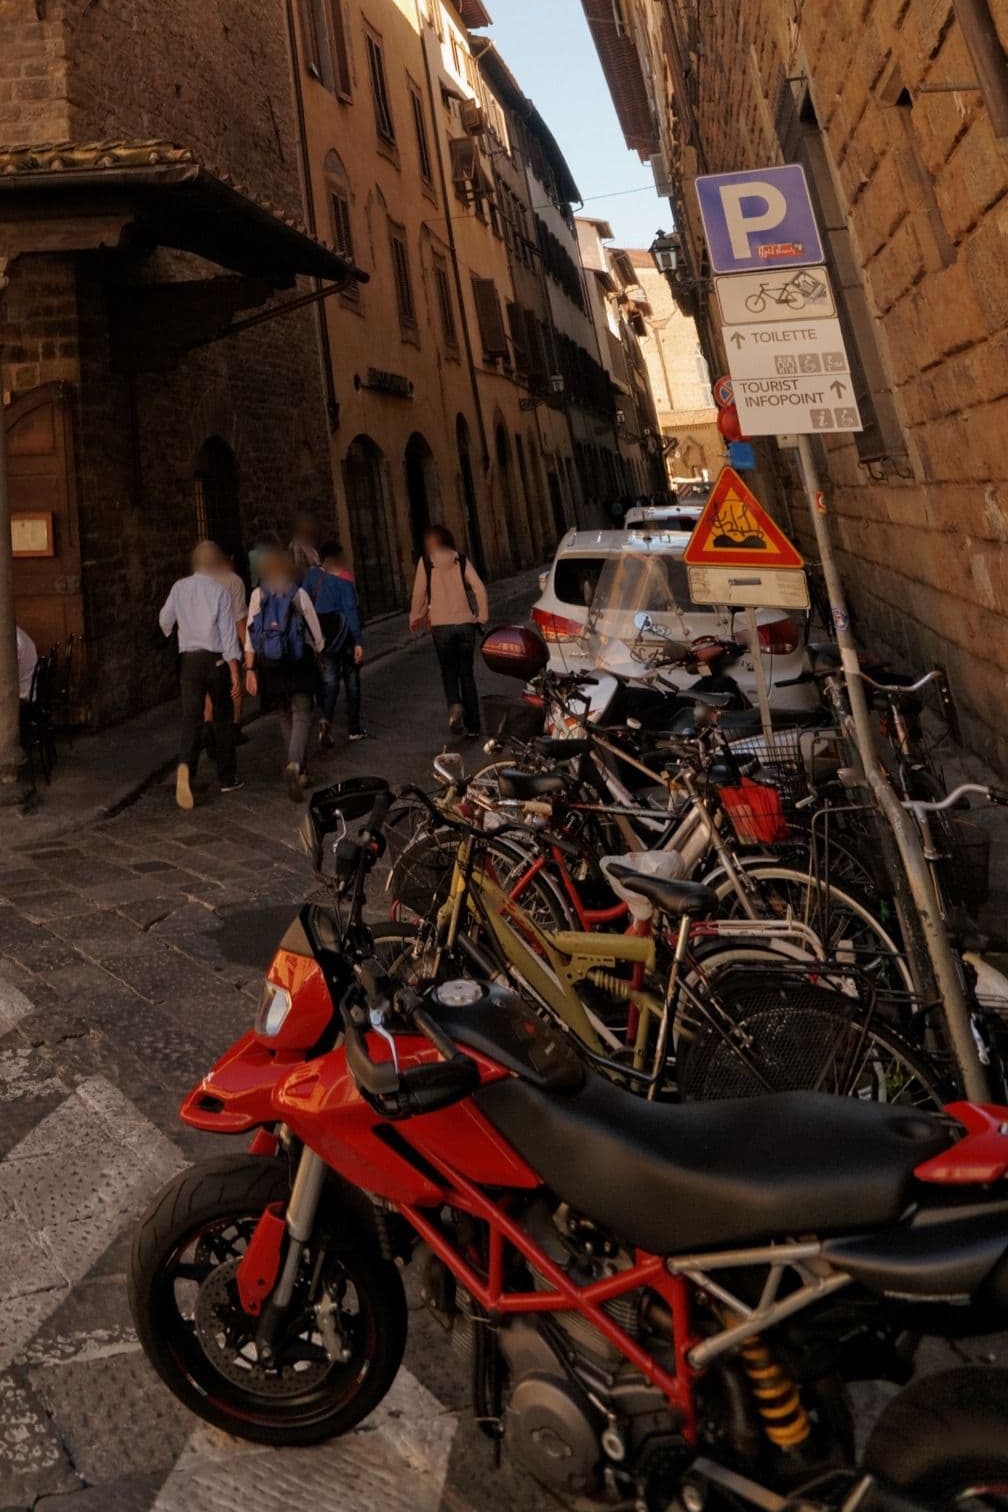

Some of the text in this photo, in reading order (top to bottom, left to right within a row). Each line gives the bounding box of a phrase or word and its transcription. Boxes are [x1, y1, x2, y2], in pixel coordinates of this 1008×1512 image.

[719, 181, 787, 261] P
[751, 328, 817, 344] TOILETTE
[739, 379, 799, 394] TOURIST
[744, 392, 825, 408] INFOPOINT
